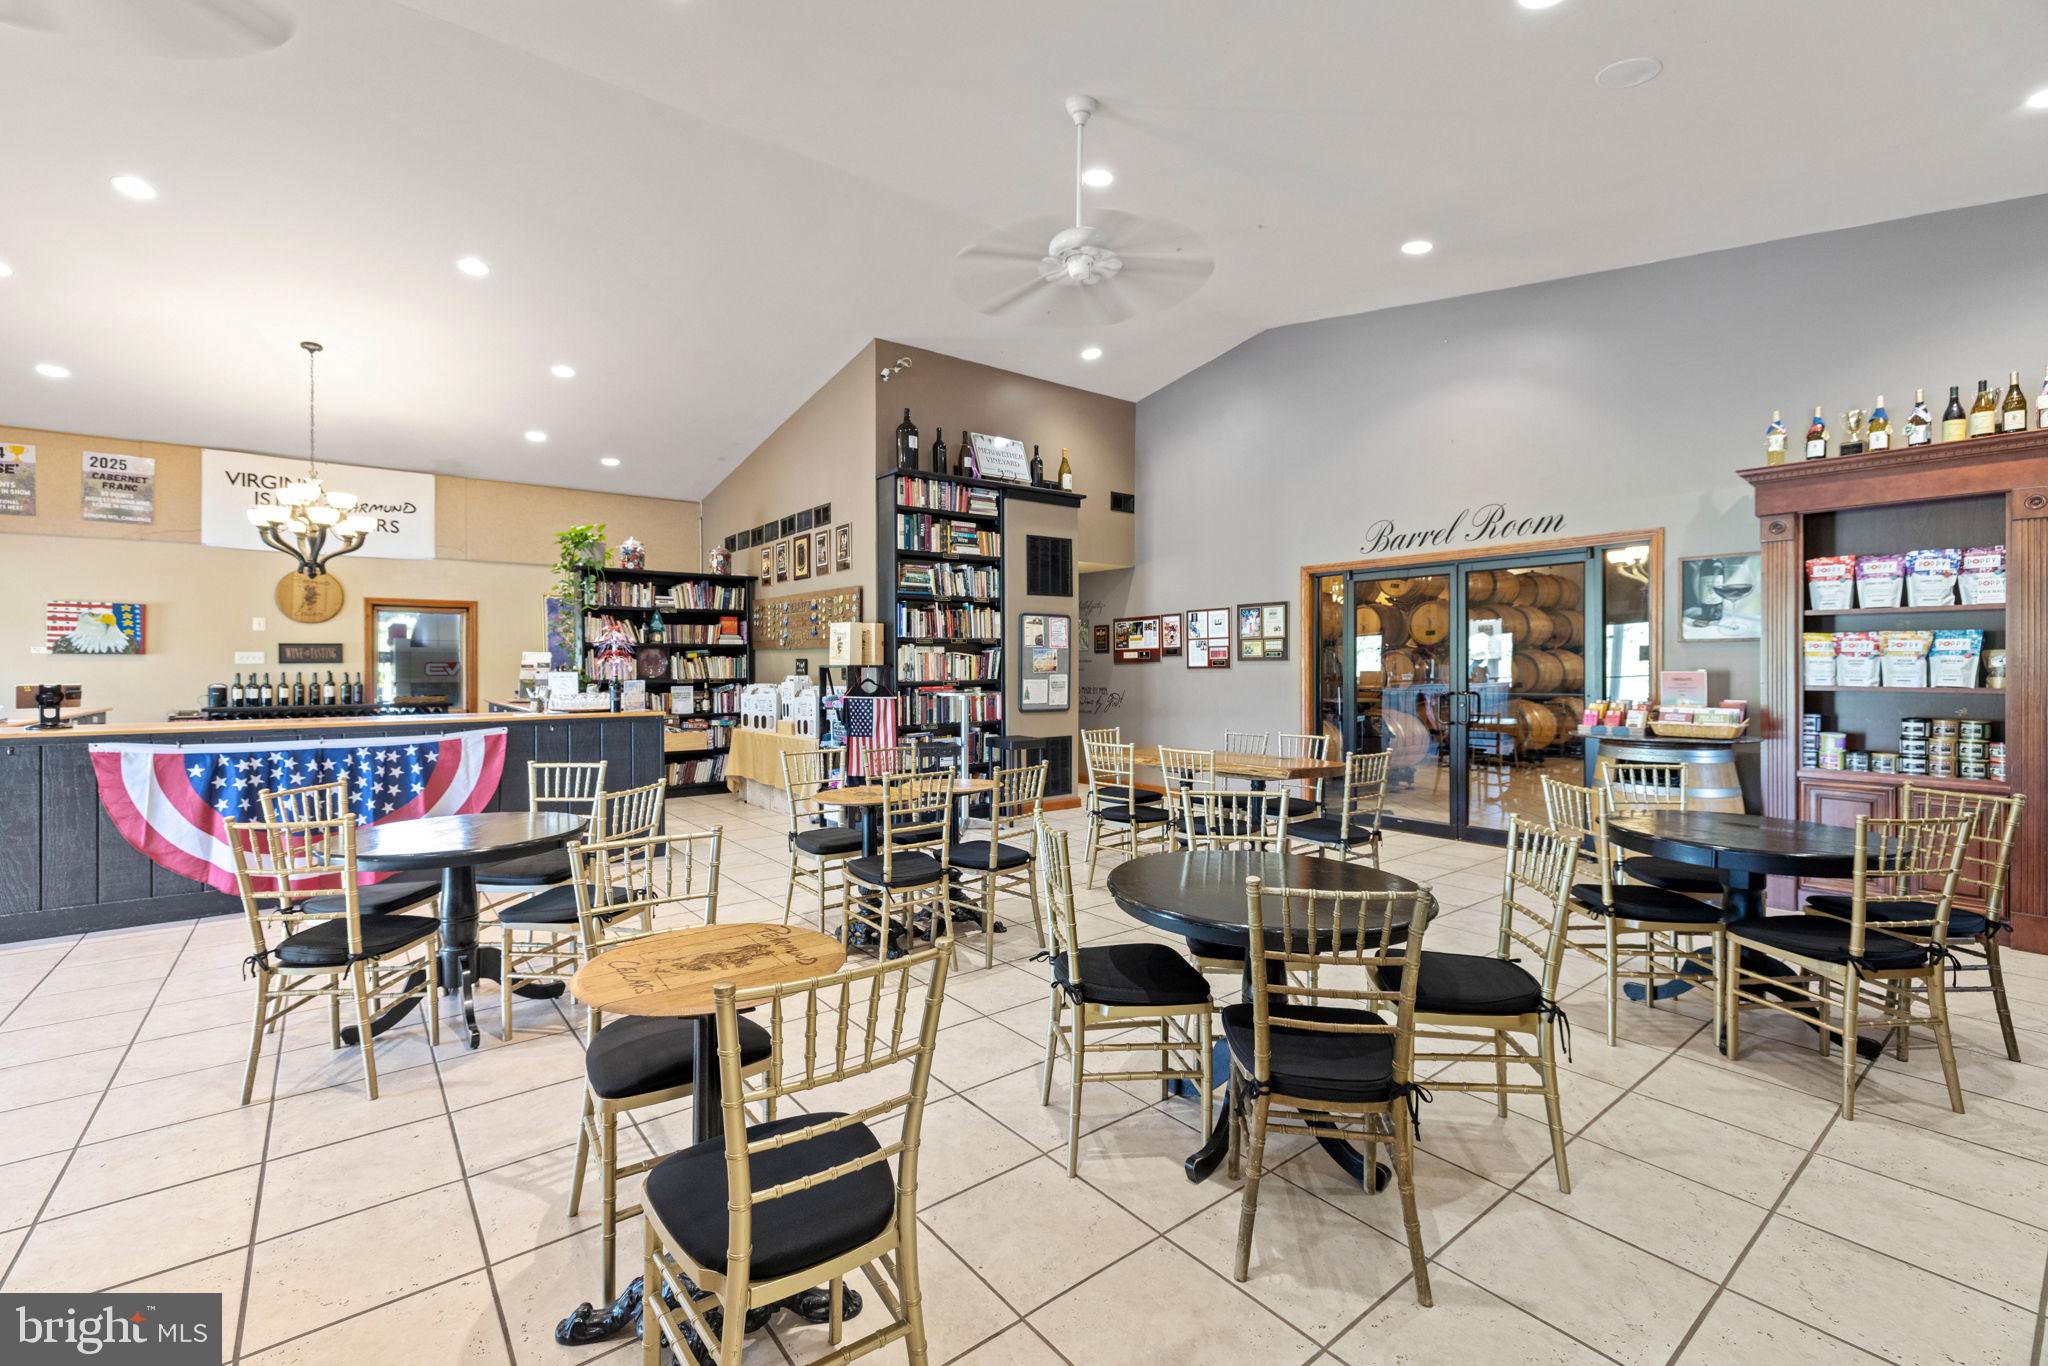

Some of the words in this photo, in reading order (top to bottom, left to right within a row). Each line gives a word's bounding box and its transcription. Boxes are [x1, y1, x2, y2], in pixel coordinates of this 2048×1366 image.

[978, 446, 1024, 460] MERIWETHER
[90, 456, 128, 470] 2025
[985, 456, 1020, 468] VINEYARD
[92, 472, 149, 484] CABERNET
[225, 470, 324, 494] VIRGI
[102, 482, 139, 492] FRANC
[255, 491, 270, 505] IS
[348, 501, 417, 515] ARMUND
[1360, 508, 1470, 554] Barrel
[1464, 502, 1568, 542] Room
[1866, 563, 1893, 571] POPPY
[1917, 559, 1947, 568] POPPY
[1966, 557, 1997, 566] POPPY
[1844, 642, 1870, 650] POPPY
[1890, 641, 1919, 649] POPPY
[1938, 640, 1967, 648] POPPY
